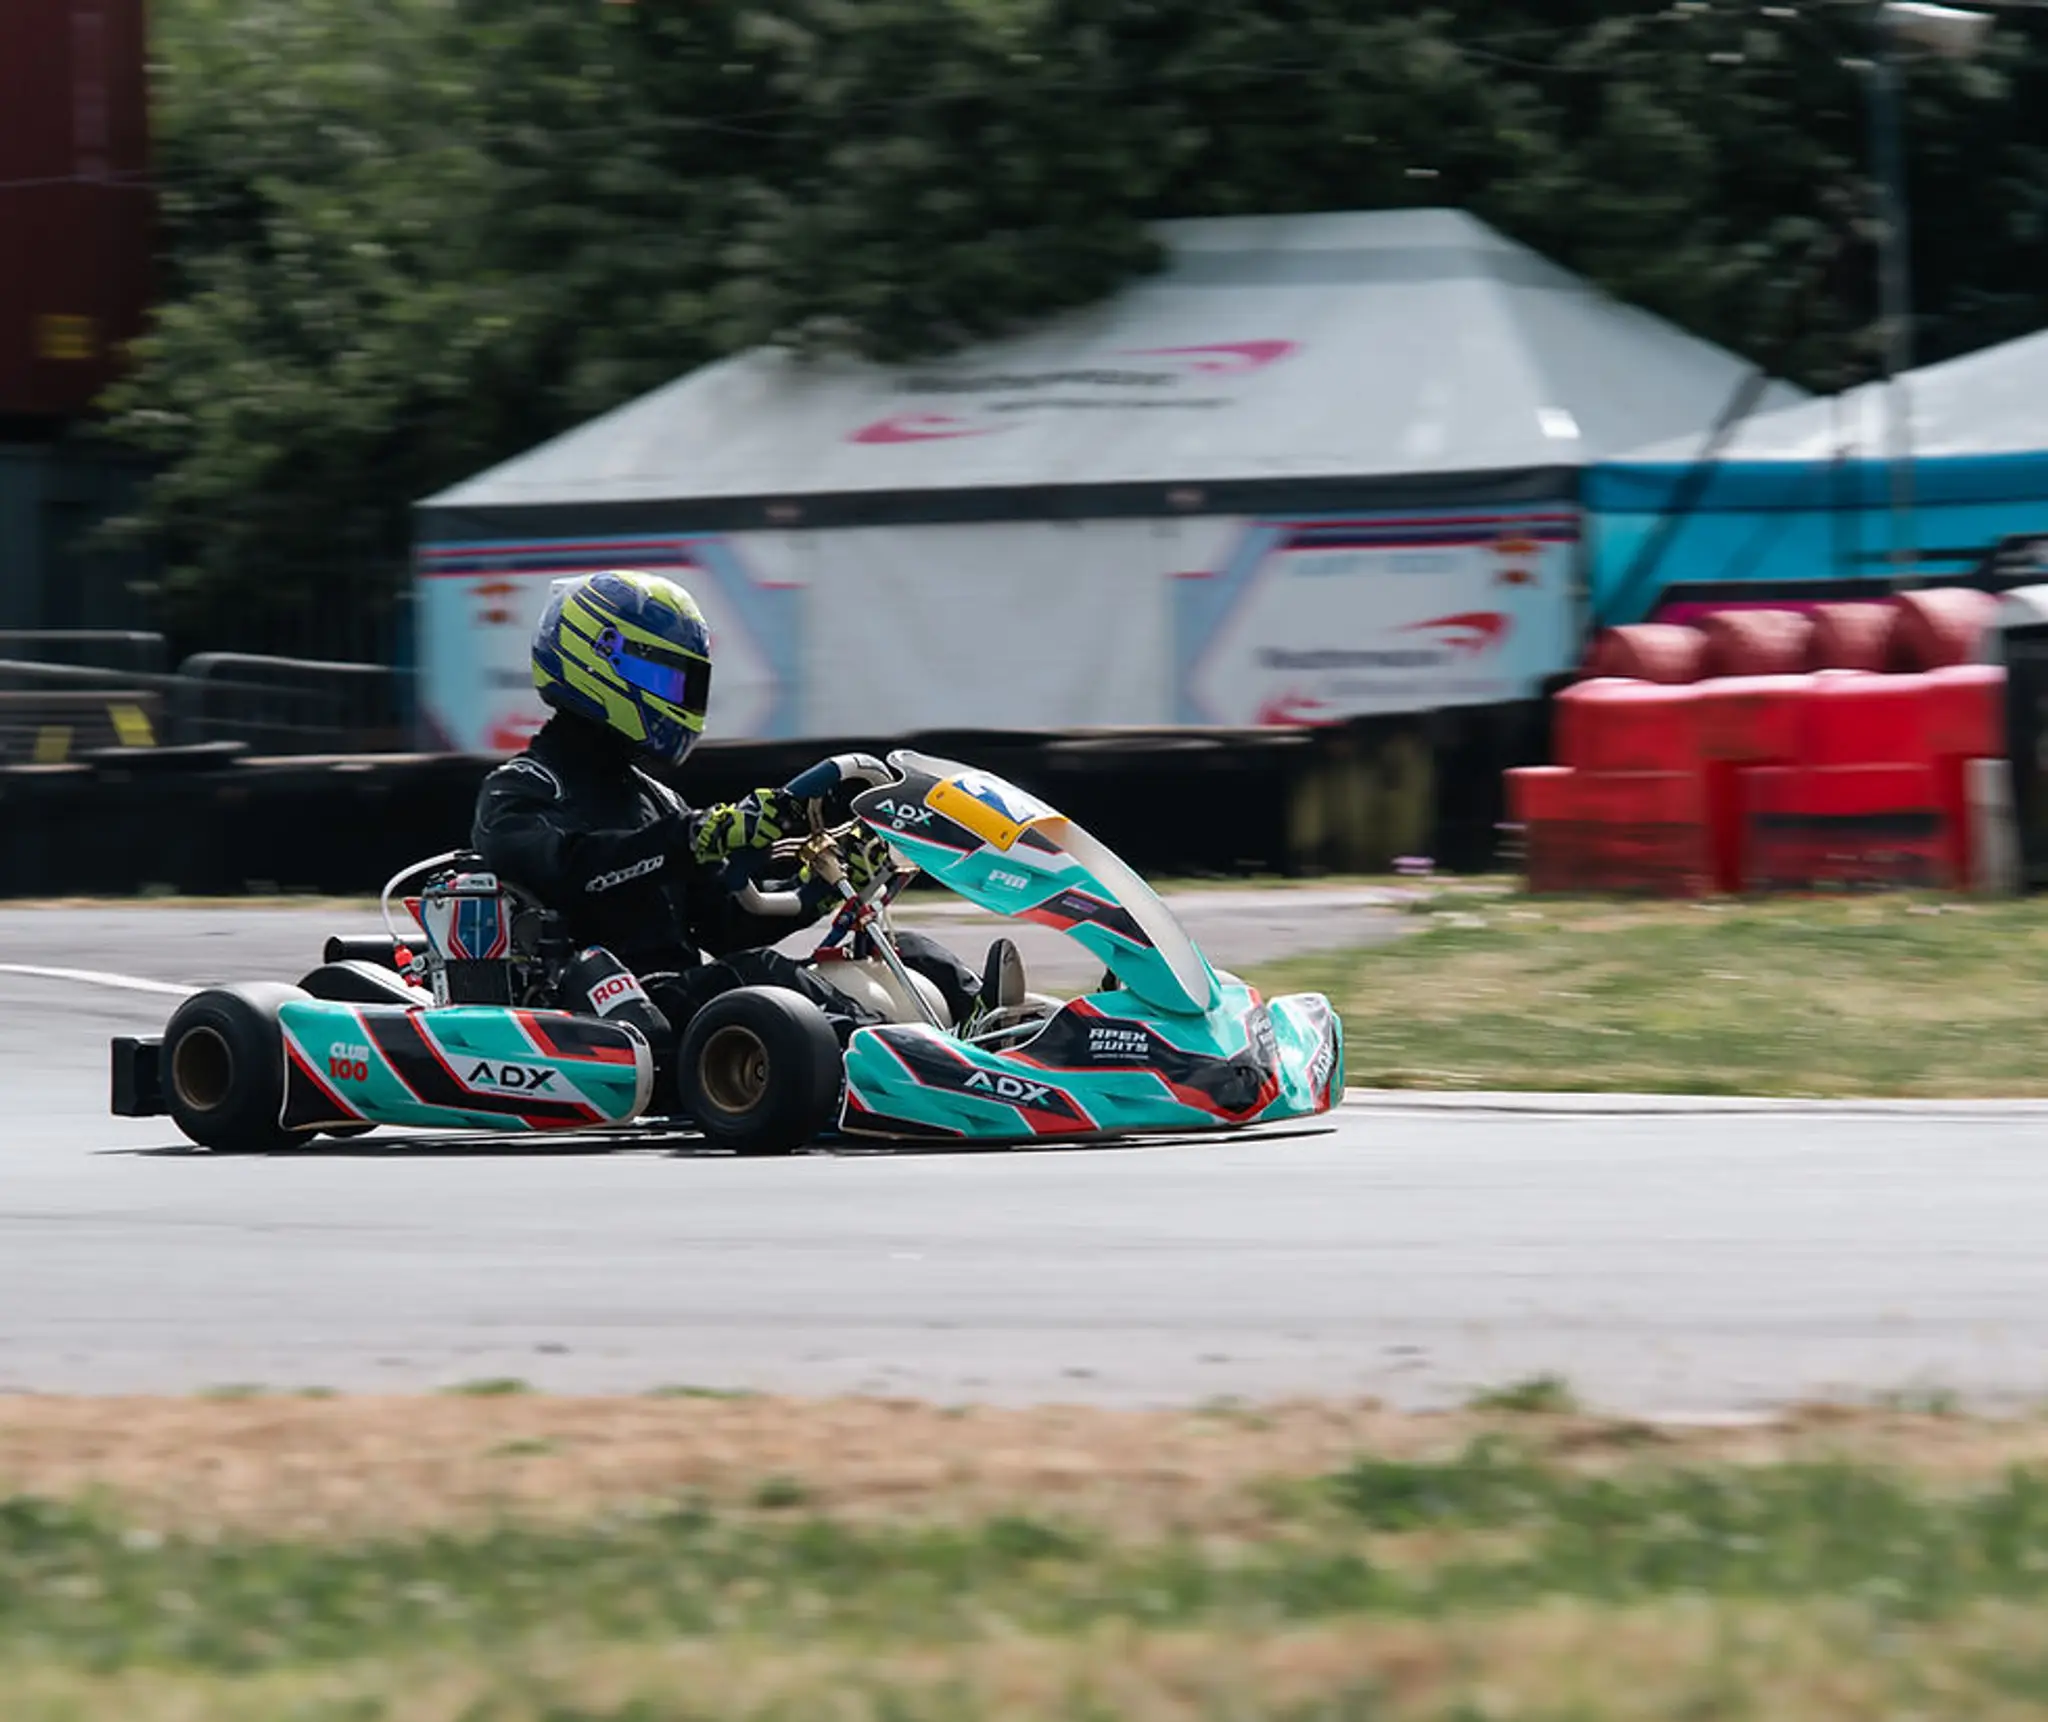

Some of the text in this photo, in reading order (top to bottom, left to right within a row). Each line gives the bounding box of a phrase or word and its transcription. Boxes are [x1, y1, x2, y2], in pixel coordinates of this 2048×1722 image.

[875, 798, 934, 827] ADX
[330, 1042, 369, 1061] CLUB
[1090, 1041, 1149, 1053] SUITS
[328, 1058, 368, 1082] 100
[468, 1061, 556, 1092] ADX
[963, 1070, 1050, 1107] ADX
